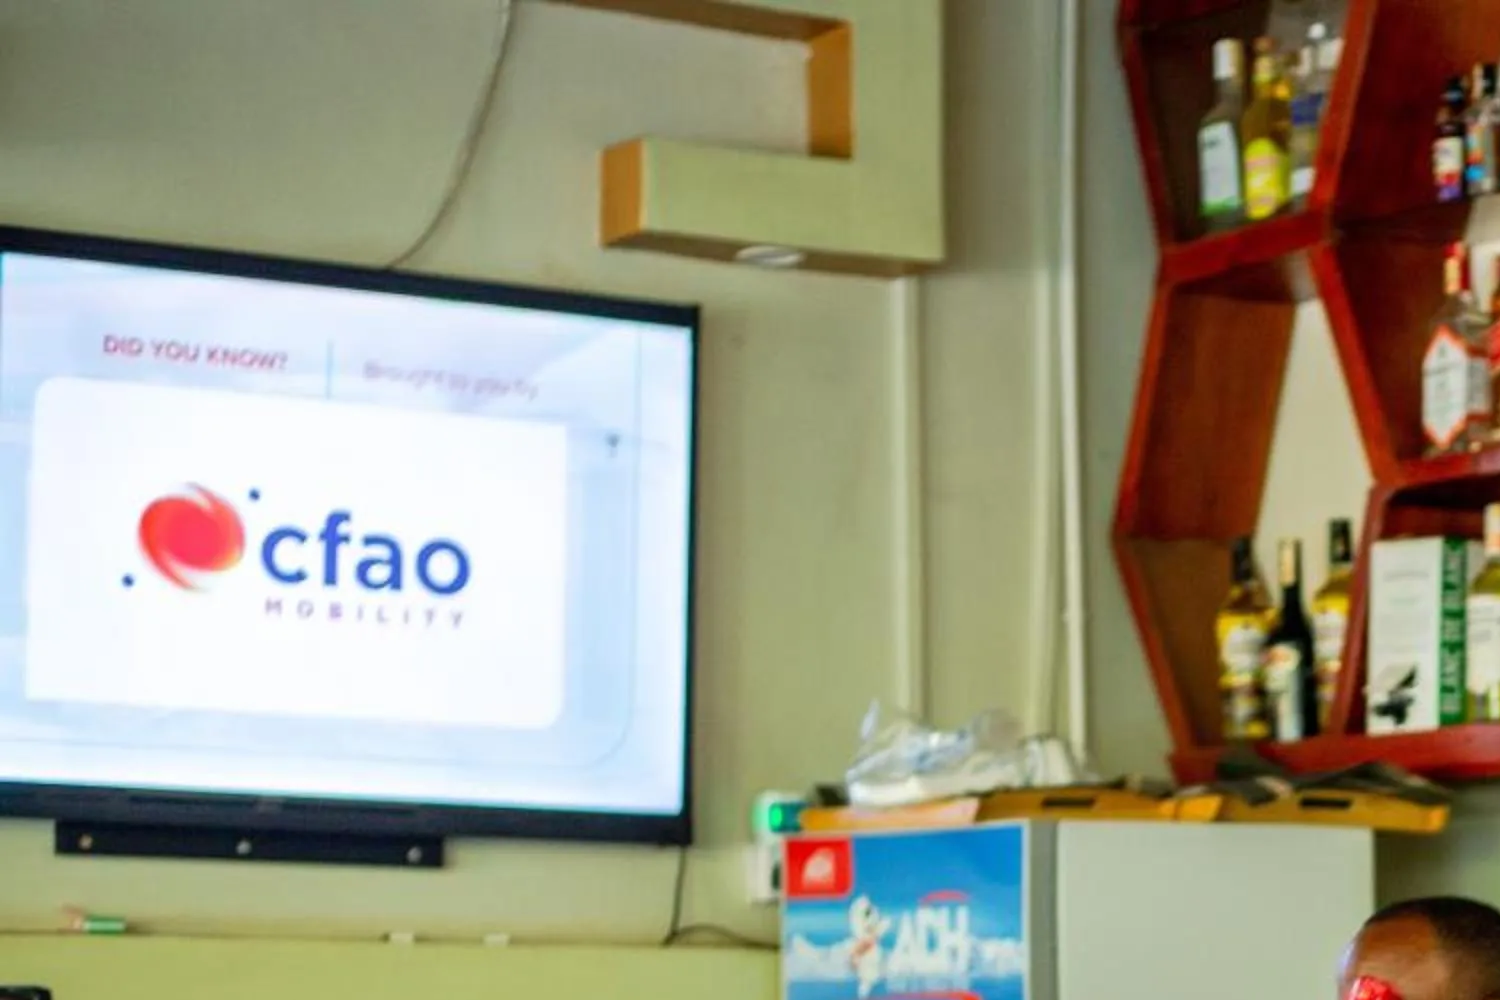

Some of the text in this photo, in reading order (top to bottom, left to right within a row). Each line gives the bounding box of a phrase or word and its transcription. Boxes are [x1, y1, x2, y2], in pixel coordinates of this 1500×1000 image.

[103, 335, 287, 370] DID YOU KNOW?
[261, 509, 470, 595] cfao
[265, 597, 463, 629] MOBILITY
